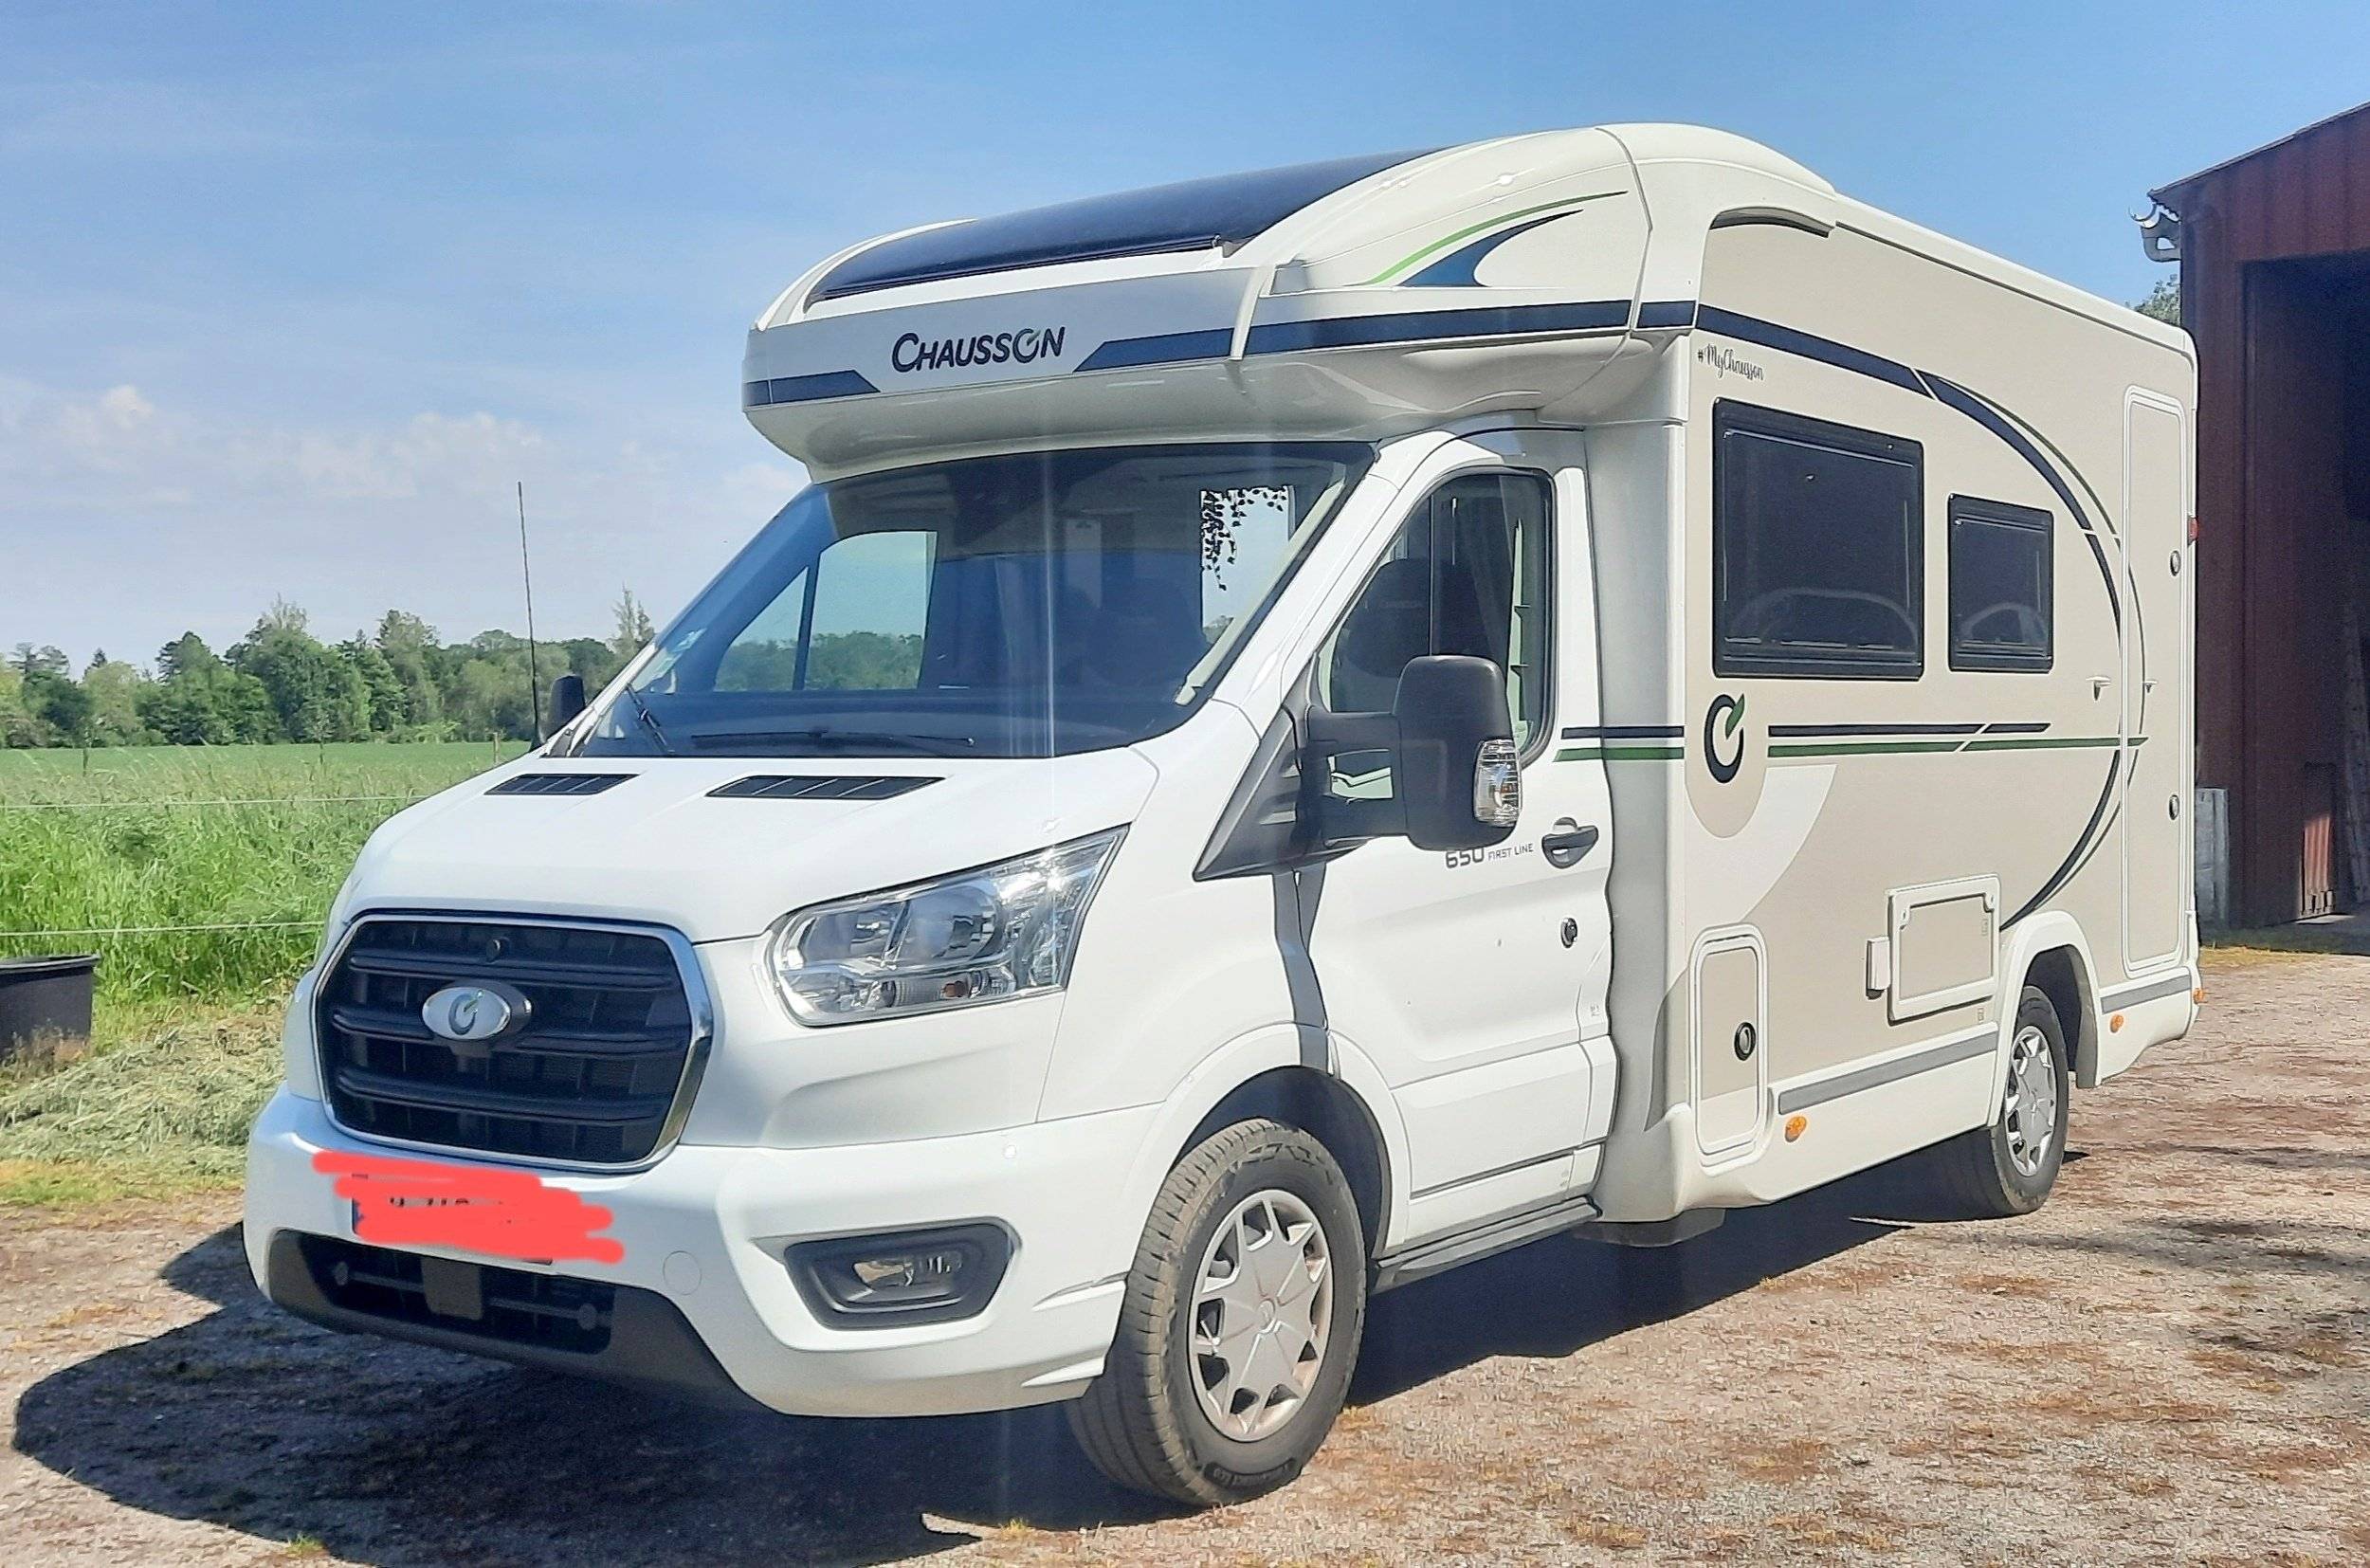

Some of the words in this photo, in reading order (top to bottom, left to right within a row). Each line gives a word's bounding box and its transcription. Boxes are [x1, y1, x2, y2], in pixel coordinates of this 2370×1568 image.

[891, 326, 1066, 373] CHAUSSON
[1445, 848, 1485, 869] 650
[1487, 848, 1512, 862] FIRST
[1515, 843, 1534, 856] LINE
